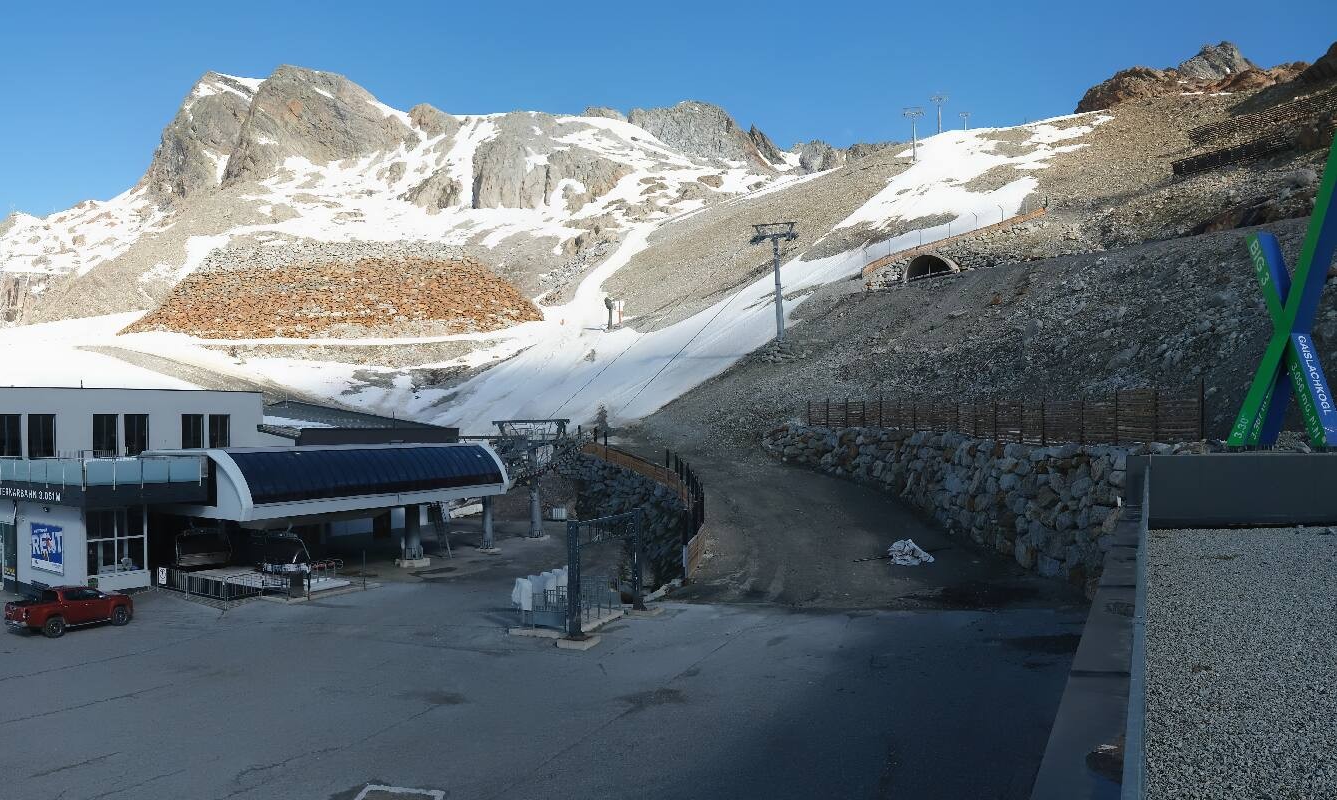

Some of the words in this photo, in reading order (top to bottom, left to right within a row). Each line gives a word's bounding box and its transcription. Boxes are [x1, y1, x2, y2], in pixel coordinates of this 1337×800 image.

[1250, 240, 1265, 272] BIG
[1261, 272, 1269, 286] 3
[1298, 335, 1332, 416] GAISLACHKOGL
